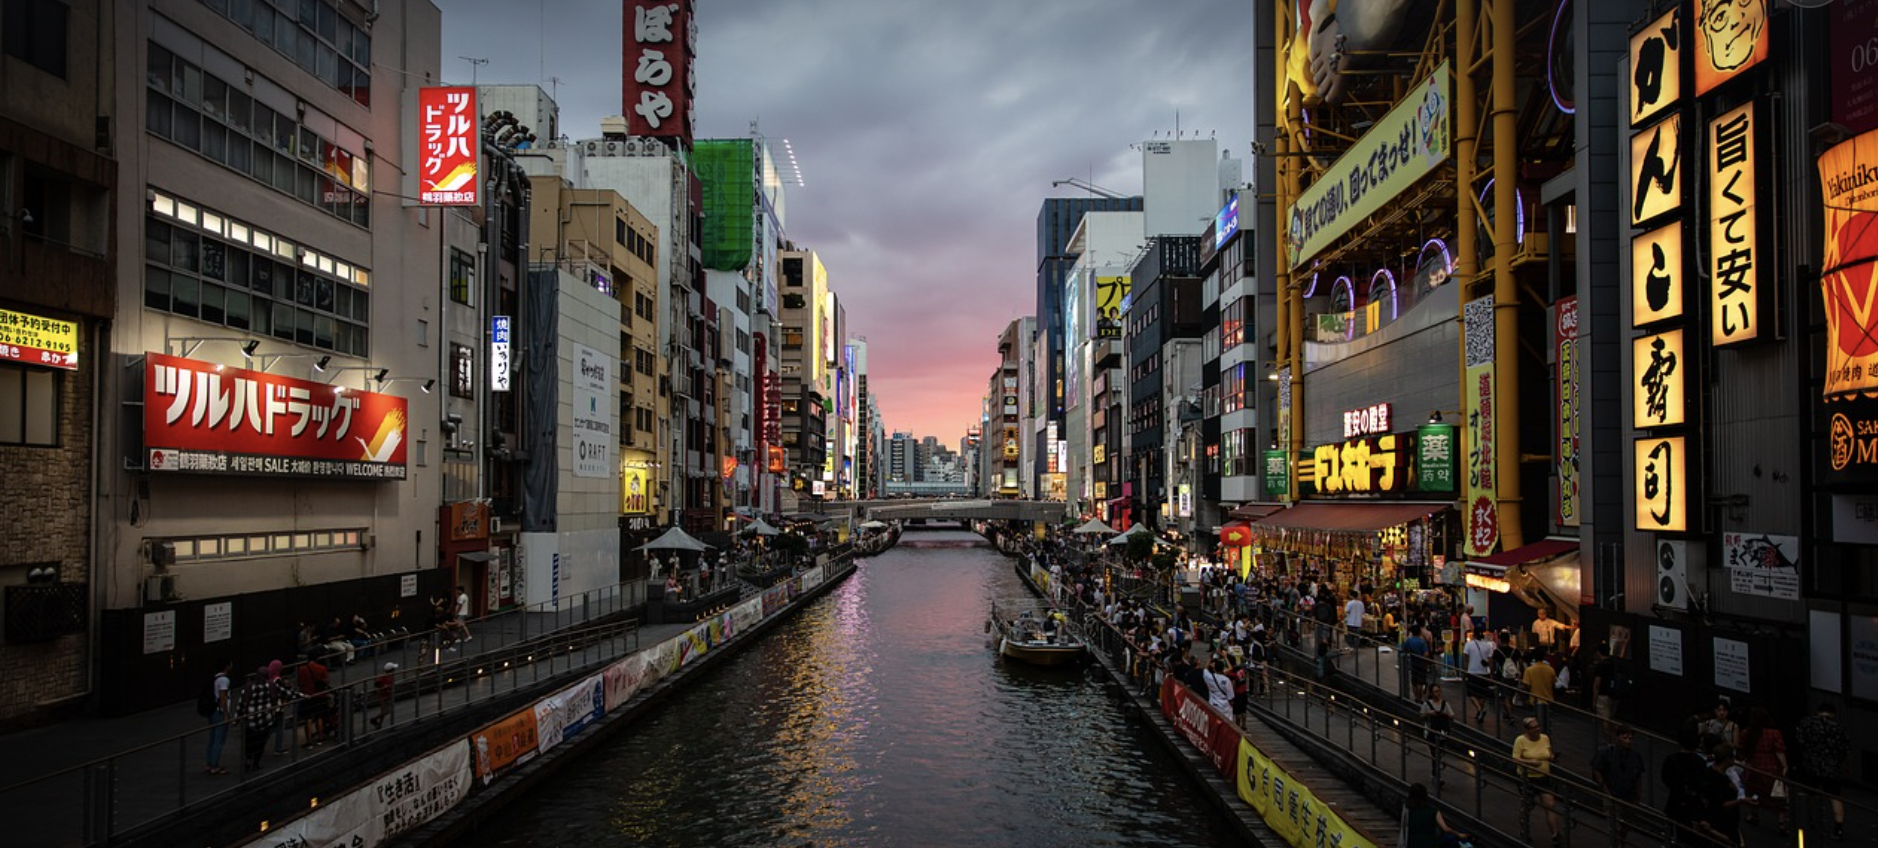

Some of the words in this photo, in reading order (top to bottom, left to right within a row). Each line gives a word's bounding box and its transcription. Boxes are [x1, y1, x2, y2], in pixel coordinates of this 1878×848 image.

[635, 3, 679, 129] ぼらや
[425, 104, 445, 175] ドラッグ
[446, 92, 471, 158] ツルハ
[1716, 112, 1752, 337] 旨くて安い
[154, 364, 360, 441] ツルハドラッグ
[264, 457, 290, 473] SALE
[346, 463, 384, 477] WELCOME
[1422, 434, 1449, 461] 薬
